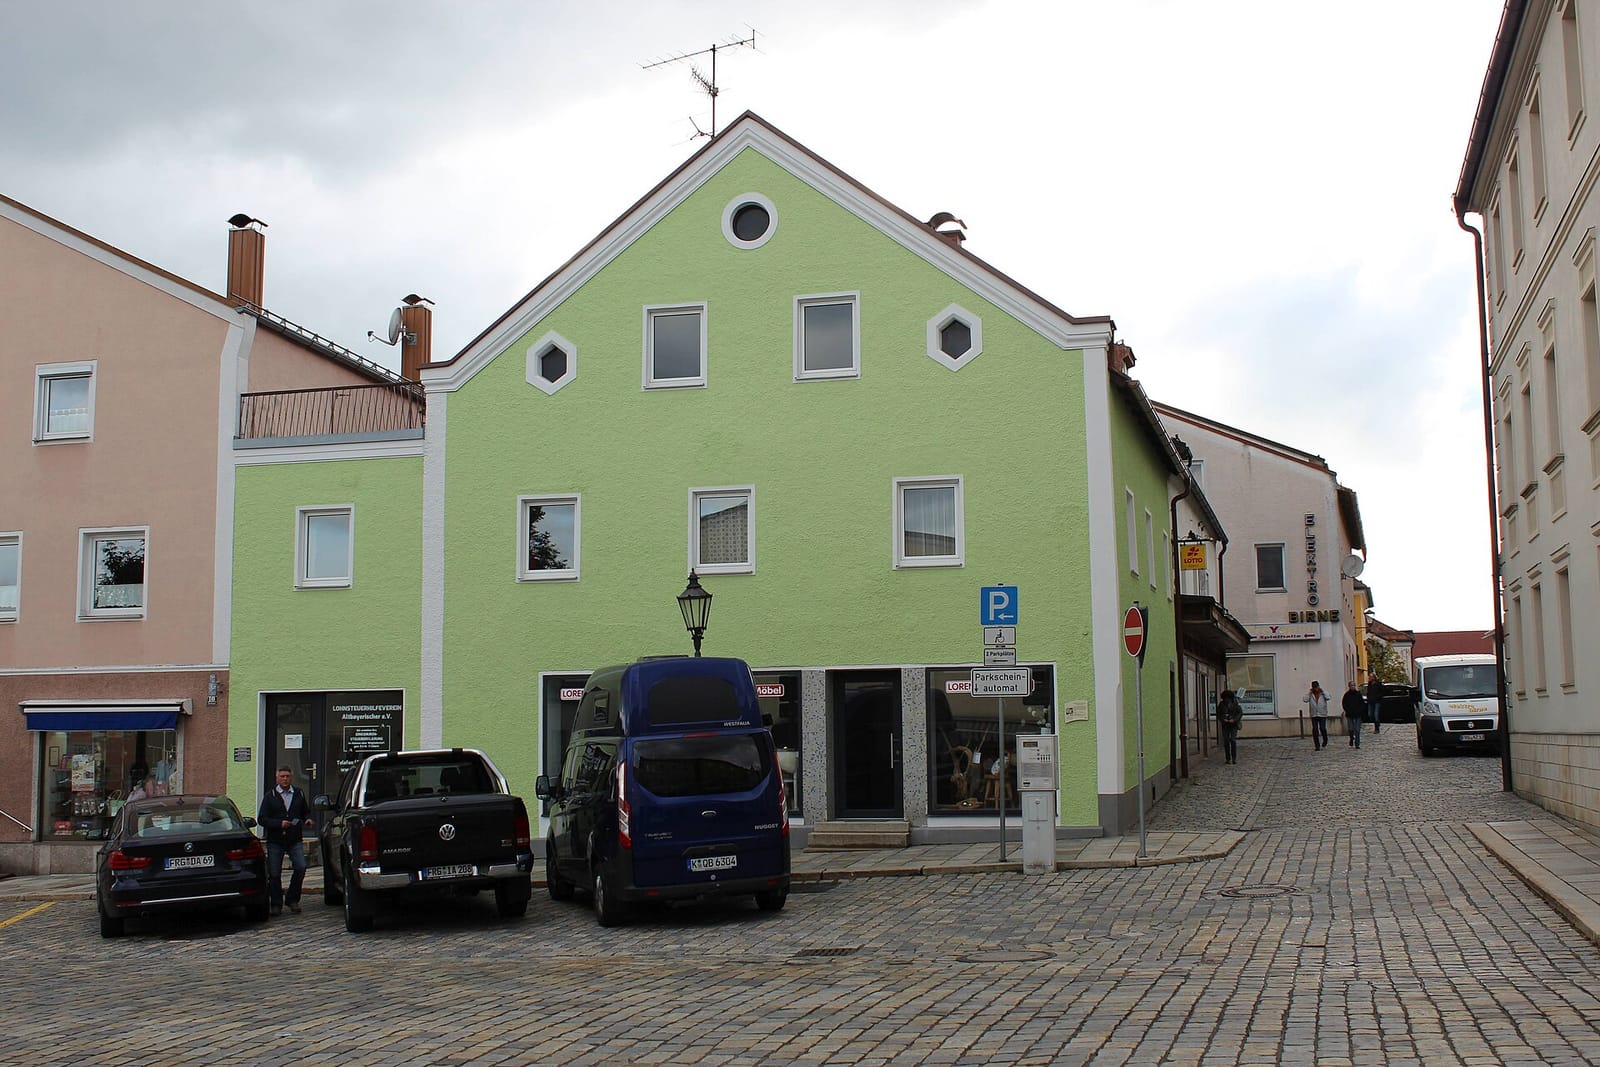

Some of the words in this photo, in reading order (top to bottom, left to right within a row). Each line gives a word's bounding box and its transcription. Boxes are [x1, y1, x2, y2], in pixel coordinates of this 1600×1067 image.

[1304, 513, 1319, 605] ELEKTRO
[989, 591, 1010, 621] P
[1288, 610, 1340, 624] BIRNE
[975, 673, 1026, 681] Parkschein-
[983, 684, 1018, 692] automat
